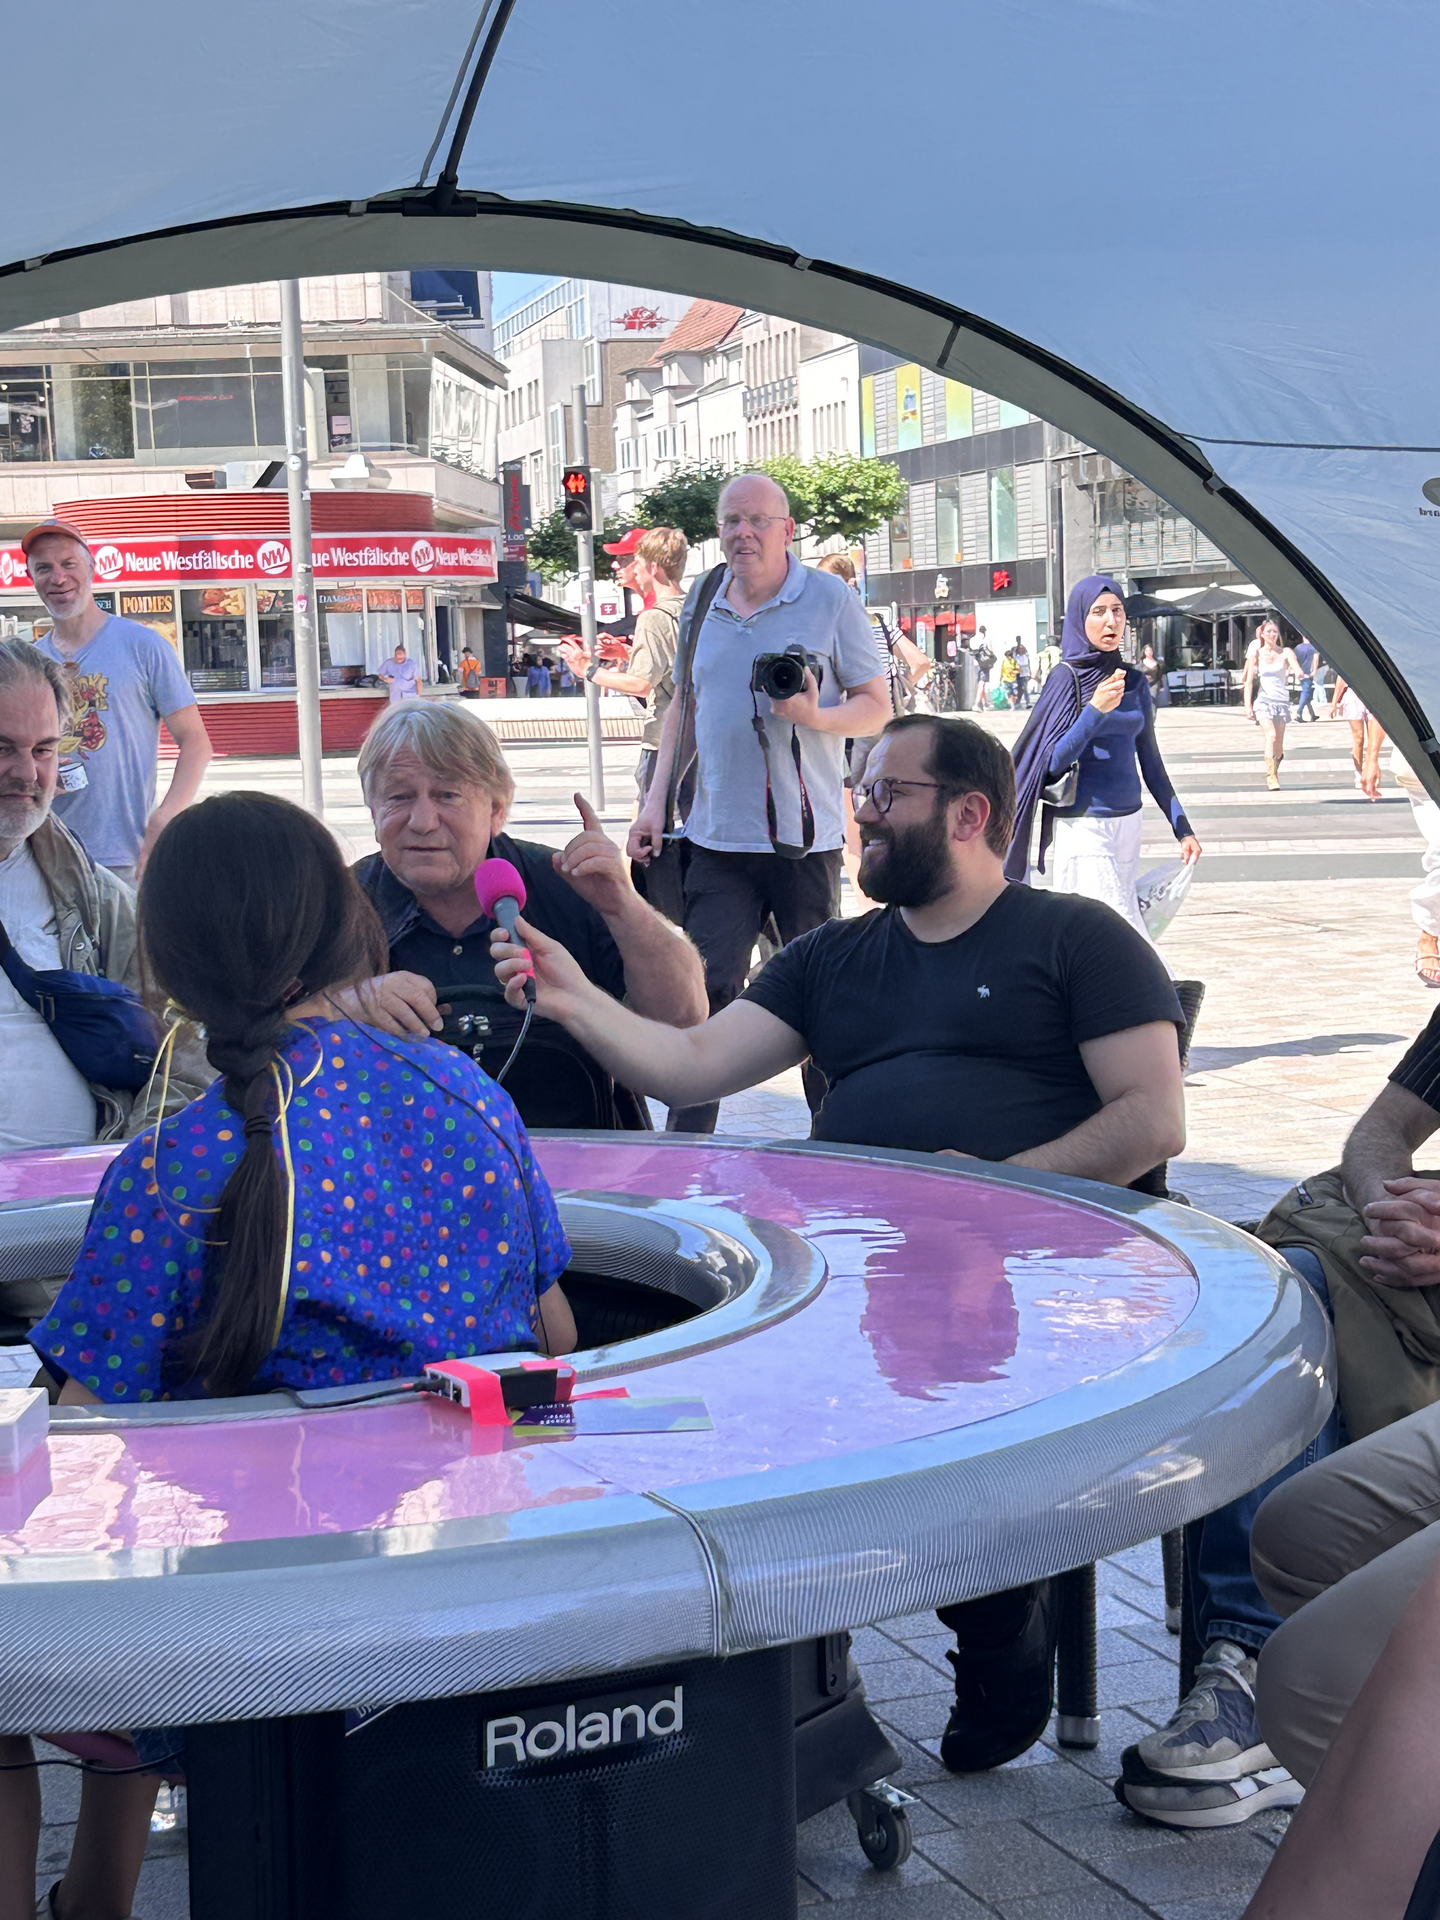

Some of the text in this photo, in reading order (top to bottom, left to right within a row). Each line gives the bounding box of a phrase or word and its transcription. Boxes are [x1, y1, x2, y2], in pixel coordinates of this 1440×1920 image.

[125, 549, 254, 572] Neue Westfälische
[330, 546, 410, 567] Westfälische
[435, 547, 459, 566] Neue
[122, 595, 173, 614] POMMES
[486, 1685, 683, 1768] Roland
